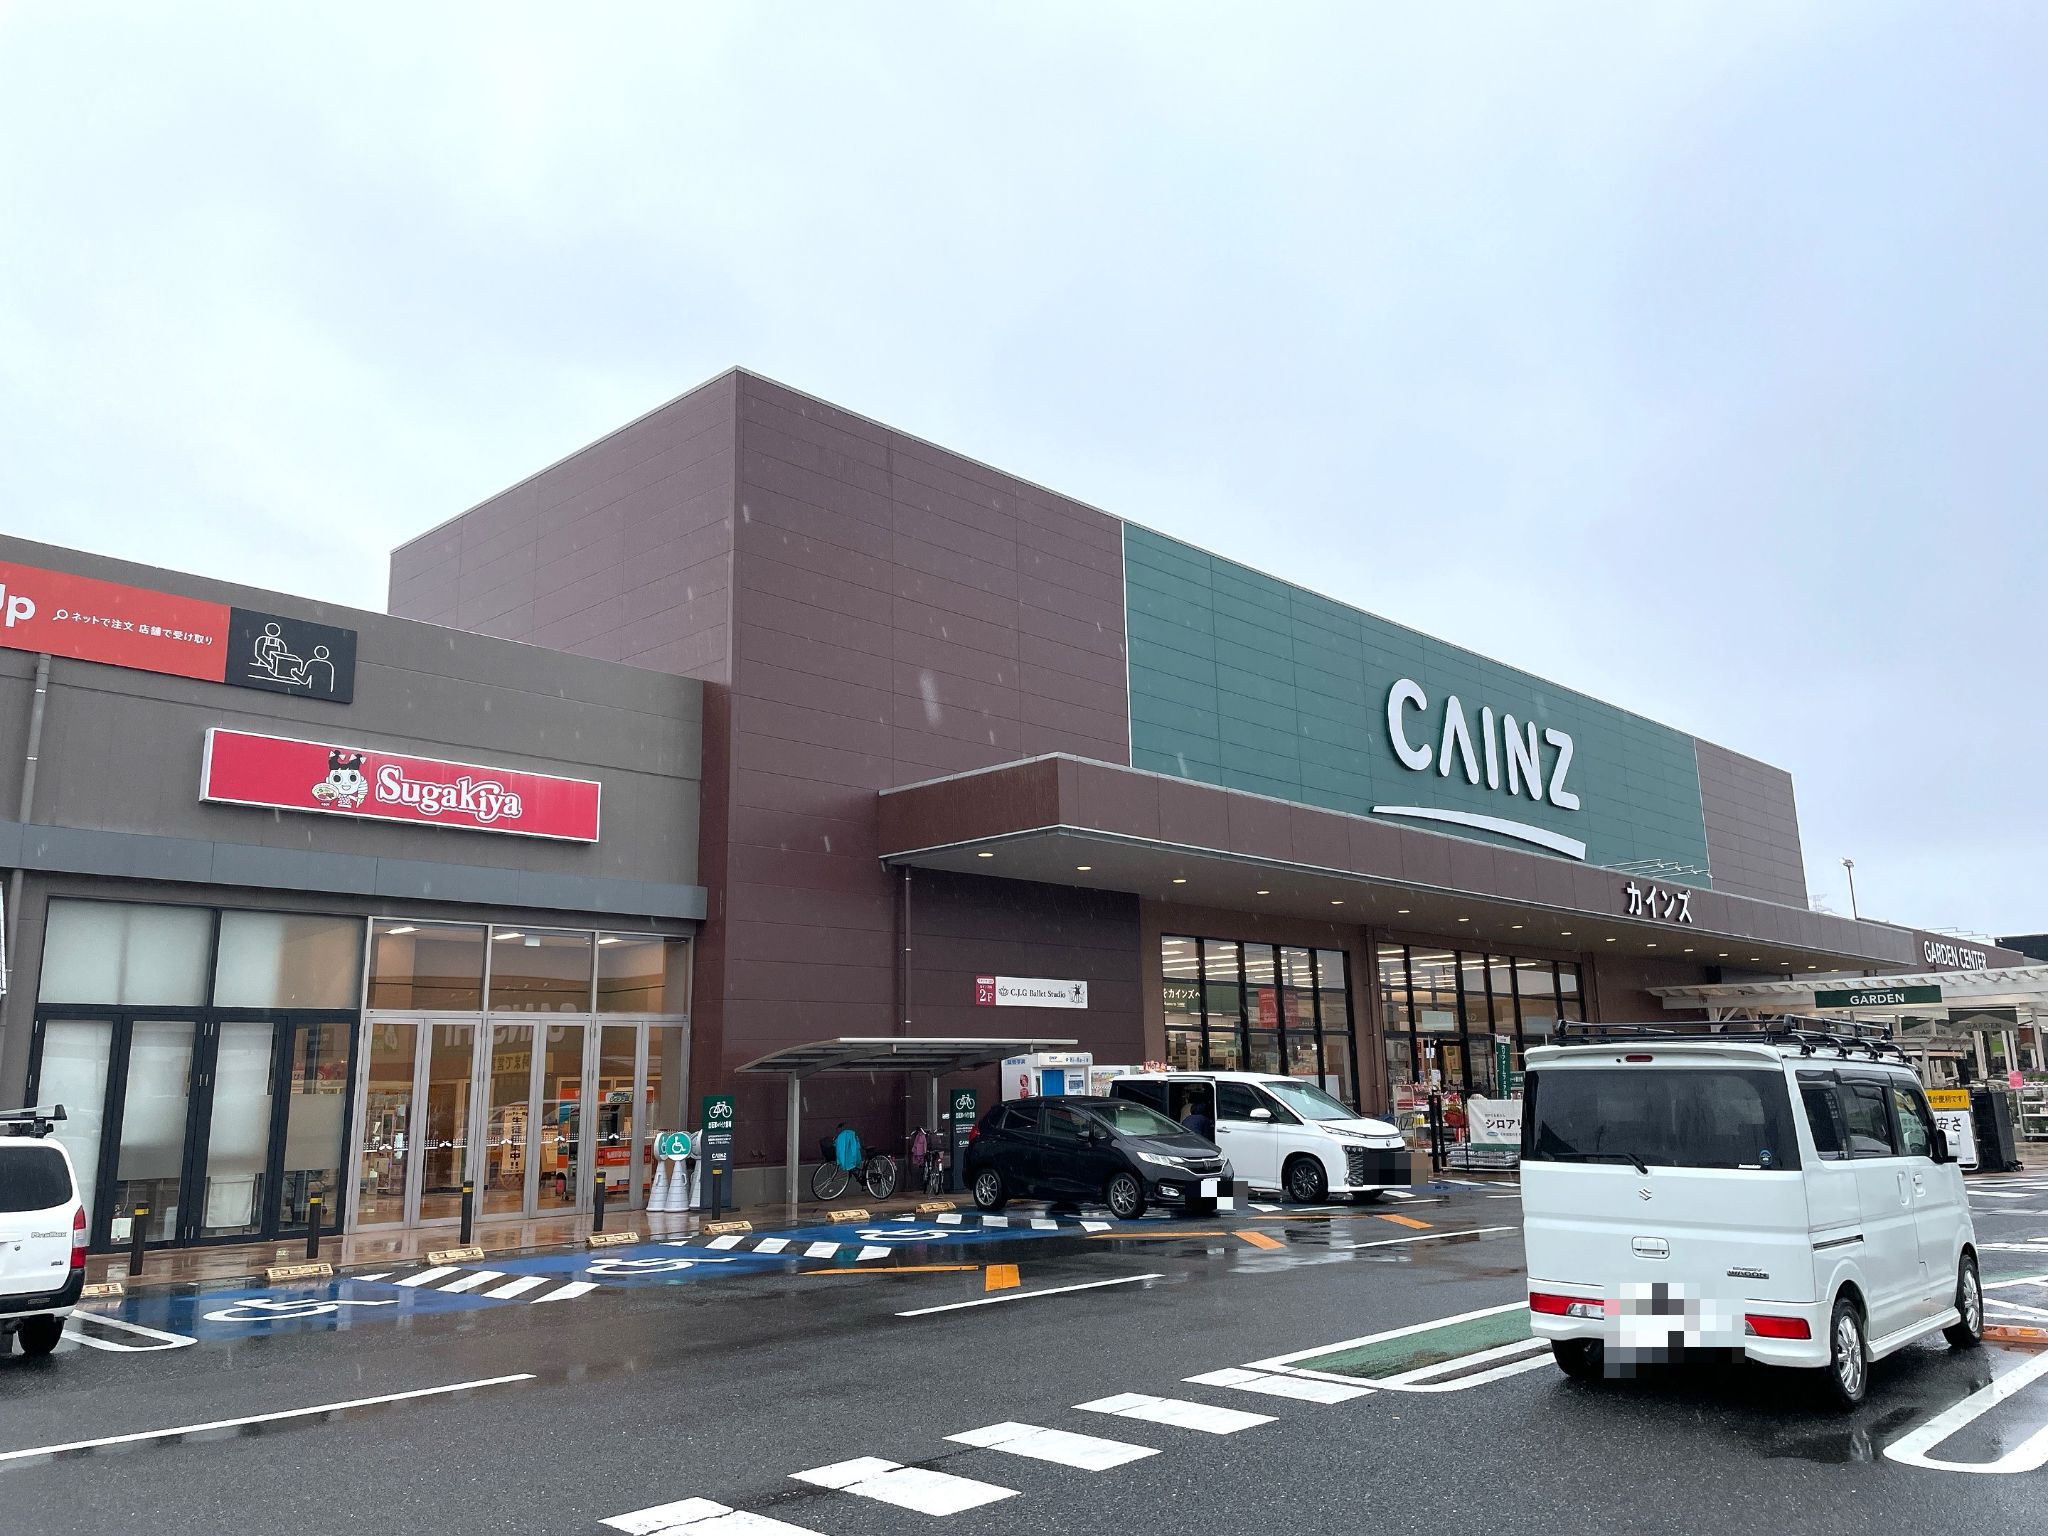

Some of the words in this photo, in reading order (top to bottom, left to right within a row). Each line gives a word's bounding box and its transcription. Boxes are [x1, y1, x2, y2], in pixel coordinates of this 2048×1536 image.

[0, 584, 36, 627] p
[72, 613, 134, 632] ネットで注文
[139, 624, 213, 645] 店舗で受け取り
[1388, 679, 1580, 811] CAINZ
[378, 767, 520, 821] Sugakiya
[1626, 881, 1693, 923] カインズ
[1924, 941, 1958, 966] GARDEN
[1958, 947, 1988, 970] CENTER
[979, 988, 994, 1002] 2F
[1030, 989, 1047, 998] Ballet
[1048, 990, 1066, 999] Studio
[1850, 993, 1905, 1005] GARDEN
[1966, 1022, 2002, 1030] GARDEN
[1936, 1116, 1962, 1132] 安さ
